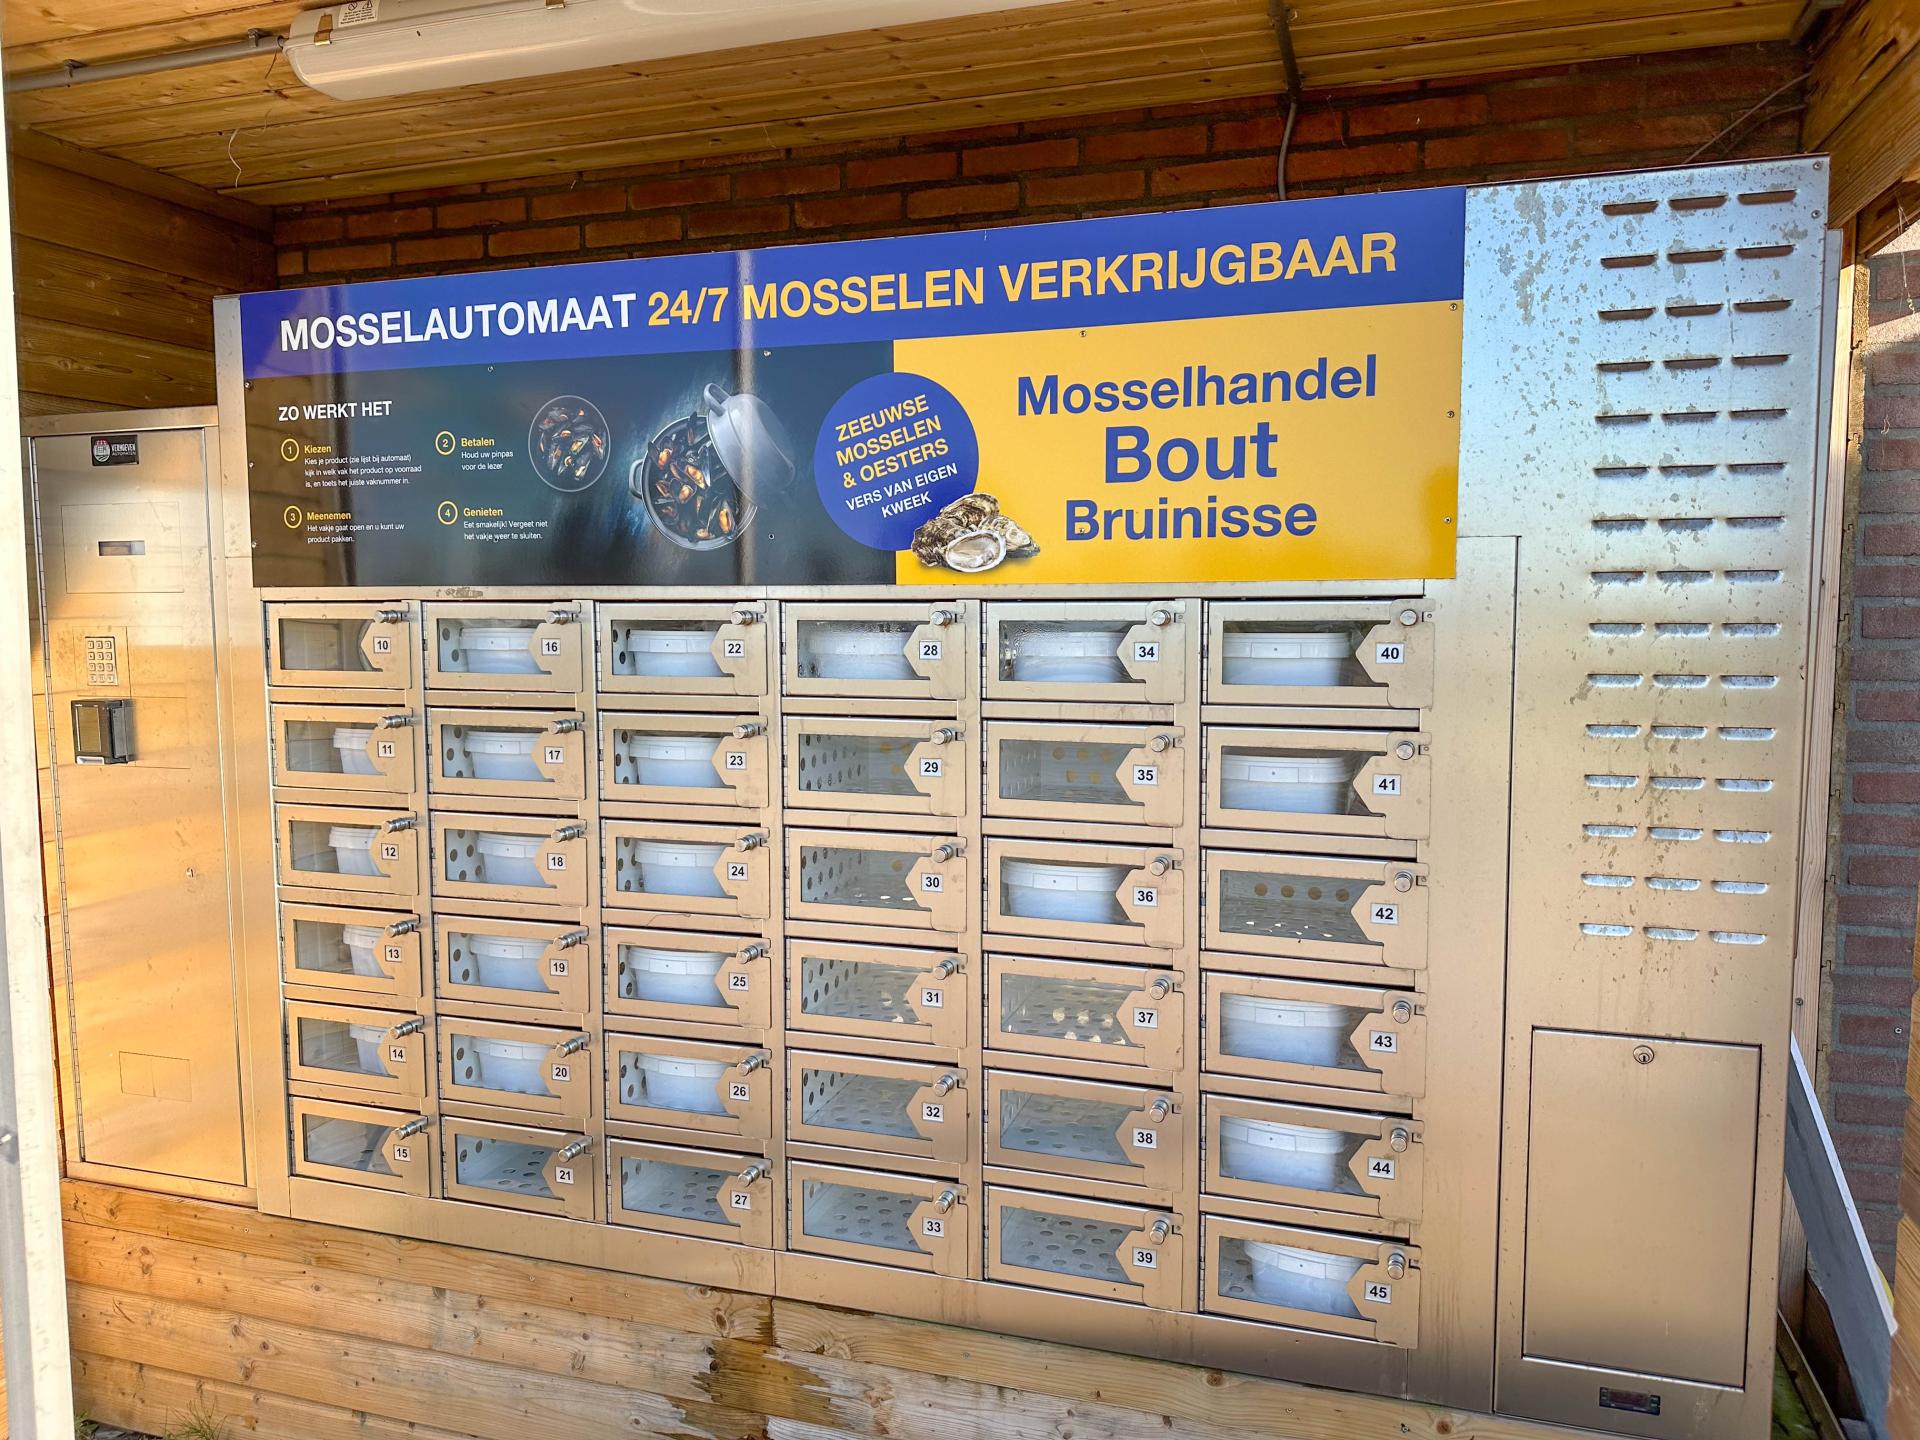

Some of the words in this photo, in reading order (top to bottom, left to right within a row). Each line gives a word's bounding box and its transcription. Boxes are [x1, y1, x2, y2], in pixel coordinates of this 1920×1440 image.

[280, 293, 636, 352] MOSSELAUTOMAAT
[648, 287, 729, 326] 24/7
[743, 266, 984, 320] MOSSELEN
[998, 231, 1397, 302] VERKRIJGBAAR
[1018, 354, 1376, 416] Mosselhandel
[278, 406, 299, 421] ZO
[303, 402, 357, 420] WERKT
[362, 400, 392, 416] HET
[835, 394, 929, 442] ZEEUWSE
[461, 438, 495, 447] Betalen
[836, 416, 942, 466] MOSSELEN
[304, 445, 332, 454] Kiezen
[491, 451, 513, 459] pinpas
[1104, 422, 1278, 484] Bout
[325, 457, 348, 465] product
[843, 472, 856, 488] &
[860, 438, 948, 482] OESTERS
[360, 466, 384, 475] product
[846, 490, 882, 511] VERS
[884, 478, 912, 497] VAN
[916, 463, 958, 486] EIGEN
[882, 492, 932, 518] KWEEK
[307, 512, 352, 520] Meenemen
[464, 508, 503, 516] Genieten
[1066, 495, 1317, 541] Bruinisse
[509, 521, 534, 529] Vergeet
[476, 533, 492, 541] vakje
[377, 640, 389, 650] 10
[545, 641, 558, 652] 16
[728, 643, 741, 654] 22
[923, 645, 938, 656] 28
[1139, 646, 1155, 658] 34
[1381, 647, 1399, 660] 40
[382, 744, 392, 754] 11
[548, 750, 561, 760] 17
[730, 755, 743, 766] 23
[924, 761, 939, 773] 29
[1137, 769, 1154, 781] 35
[1378, 778, 1395, 791] 41
[384, 846, 396, 857] 12
[551, 856, 564, 867] 18
[731, 865, 745, 876] 24
[925, 876, 940, 888] 30
[1137, 890, 1154, 902] 36
[1375, 907, 1394, 920] 42
[388, 948, 400, 959] 13
[553, 962, 565, 973] 19
[733, 976, 746, 987] 25
[926, 991, 939, 1003] 31
[1138, 1011, 1154, 1024] 37
[1374, 1035, 1393, 1048] 43
[392, 1049, 404, 1059] 14
[555, 1066, 567, 1078] 20
[733, 1085, 746, 1097] 26
[926, 1106, 940, 1118] 32
[1137, 1131, 1153, 1144] 38
[397, 1148, 408, 1158] 15
[1372, 1161, 1391, 1175] 44
[559, 1169, 572, 1181] 21
[734, 1194, 748, 1206] 27
[926, 1221, 941, 1233] 33
[1137, 1251, 1153, 1264] 39
[1369, 1285, 1387, 1299] 45
